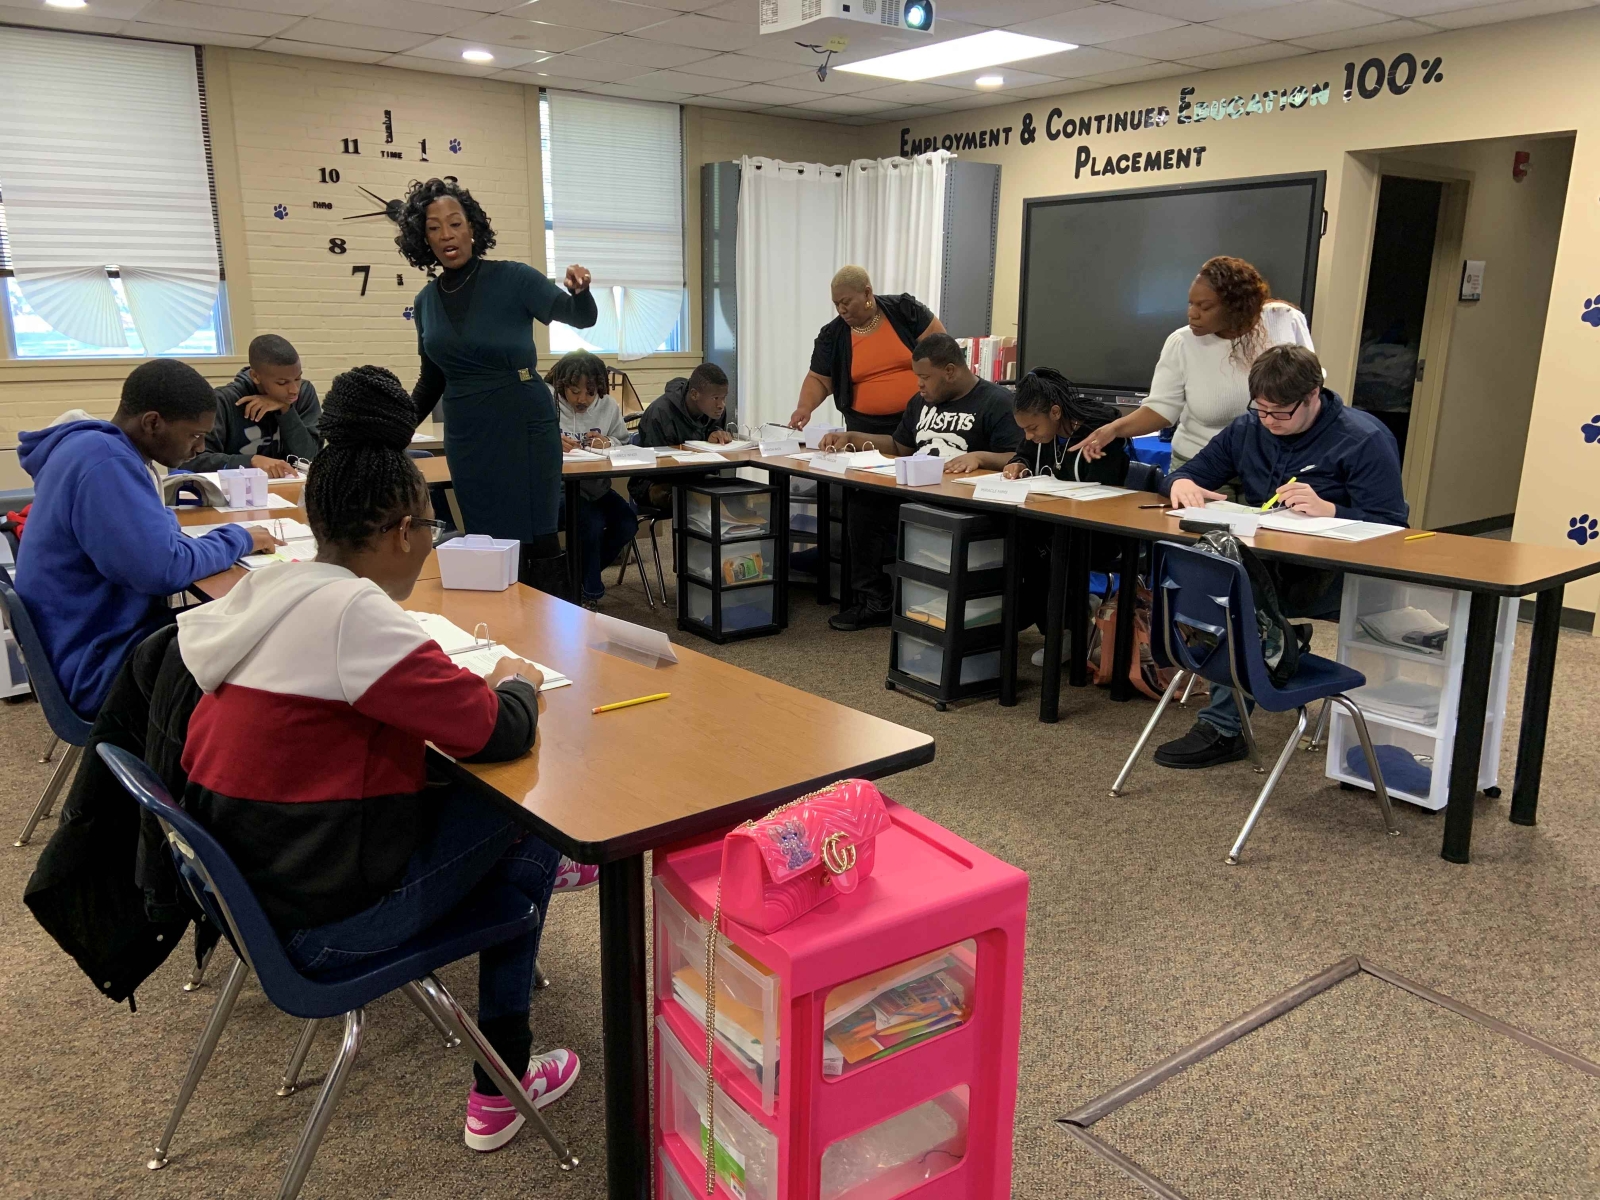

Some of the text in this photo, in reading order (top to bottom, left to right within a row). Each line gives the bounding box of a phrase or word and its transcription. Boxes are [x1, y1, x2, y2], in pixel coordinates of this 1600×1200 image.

[900, 53, 1443, 157] EMPLOYMENT & CONTINUED EDUCATION 100%
[341, 138, 361, 154] 11
[380, 150, 403, 160] TIME
[418, 138, 429, 162] 1
[1074, 146, 1207, 179] PLACEMENT
[318, 167, 340, 183] 10
[328, 238, 347, 254] 8
[351, 265, 370, 296] 7
[915, 404, 975, 431] MISFITS
